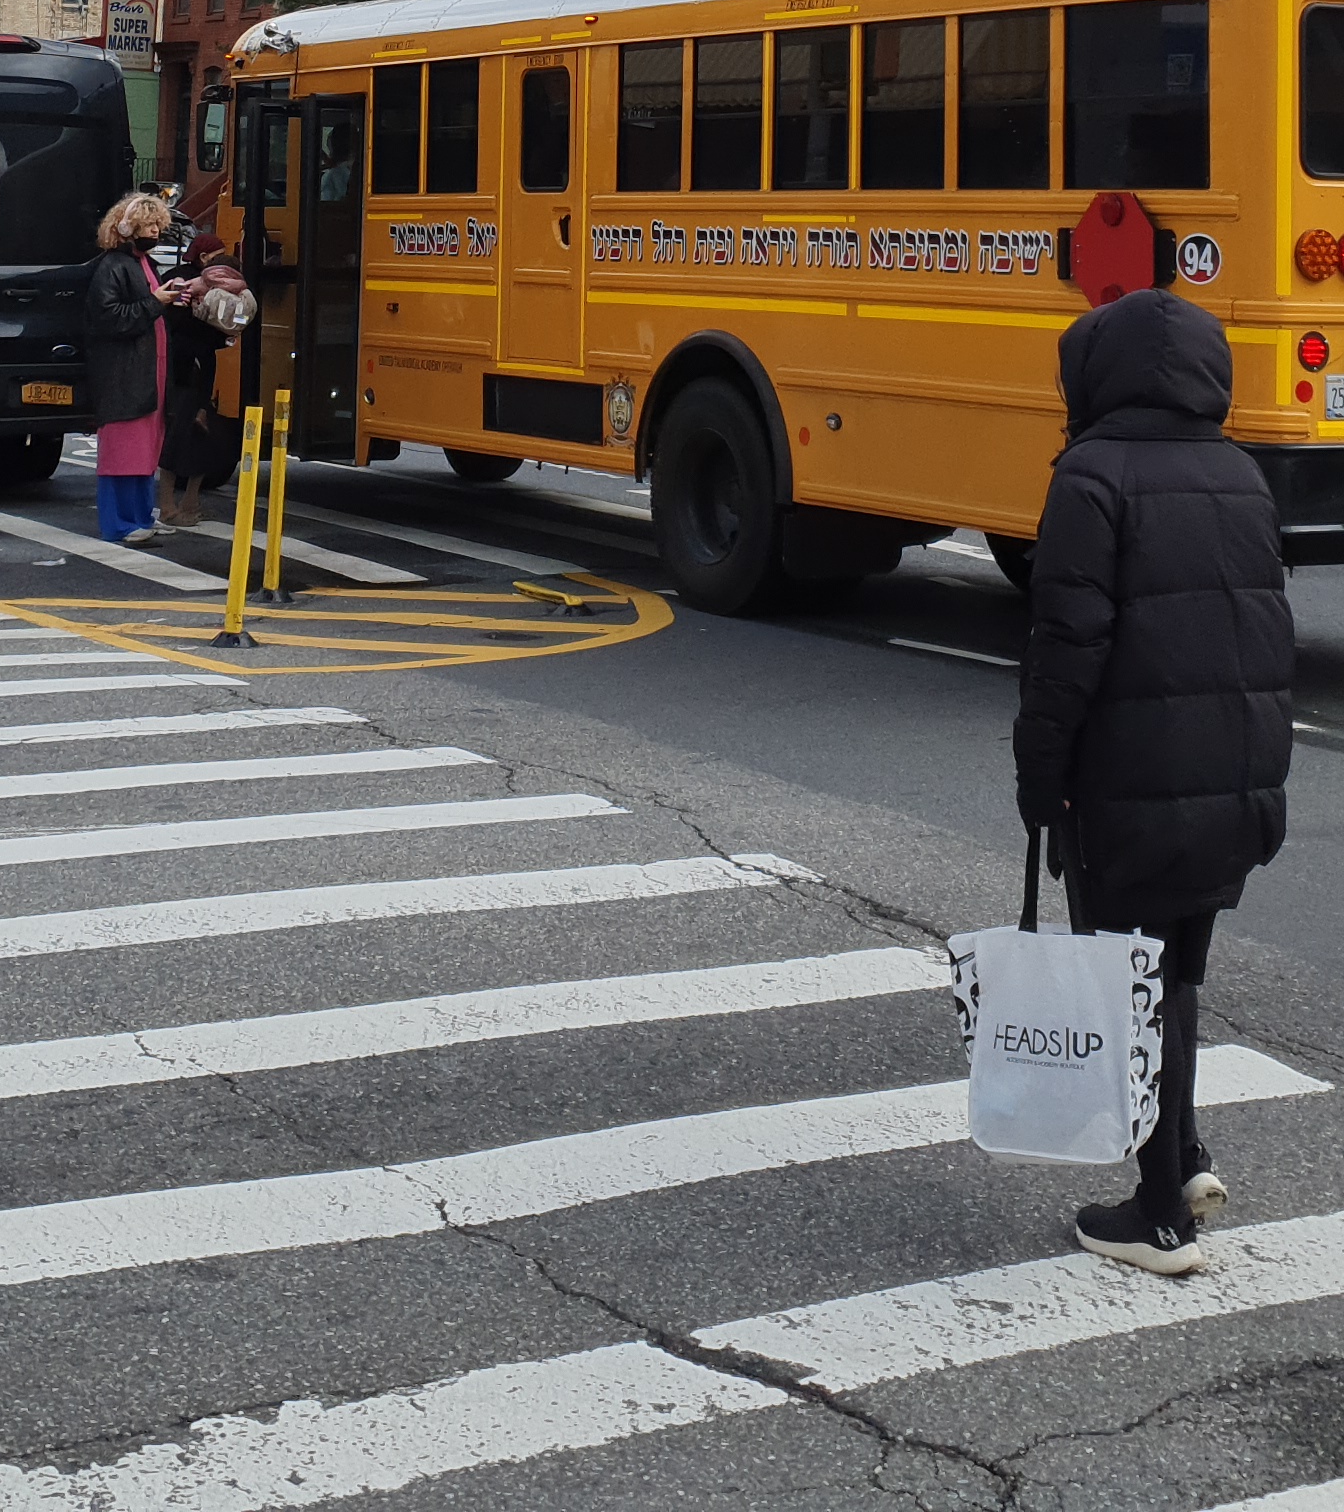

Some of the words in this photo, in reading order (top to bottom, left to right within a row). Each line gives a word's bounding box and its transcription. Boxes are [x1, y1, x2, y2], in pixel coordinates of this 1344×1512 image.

[109, 1, 144, 14] Bravo
[113, 17, 148, 34] SUPER
[108, 34, 152, 53] MARKET
[465, 216, 498, 257] יואל
[590, 224, 644, 262] דרבינו
[650, 219, 687, 263] רחל
[692, 225, 736, 265] ובית
[739, 226, 798, 266] ויראה
[805, 227, 861, 268] תורה
[868, 227, 970, 272] ומתיבתא
[977, 229, 1053, 274] ישיבה
[1184, 242, 1214, 277] 94
